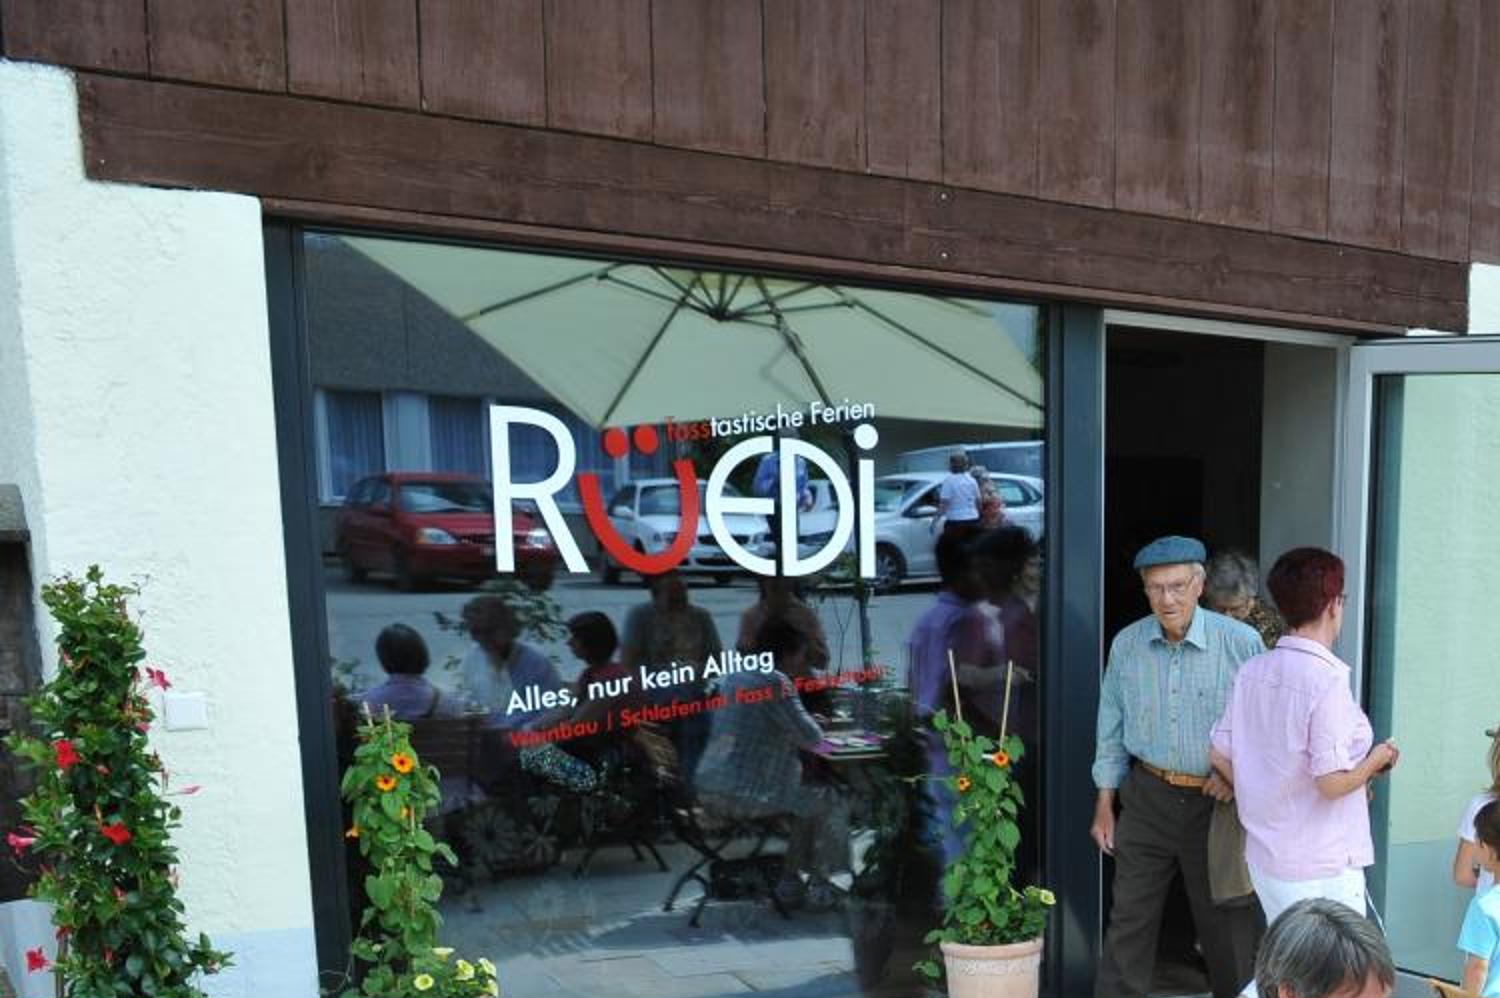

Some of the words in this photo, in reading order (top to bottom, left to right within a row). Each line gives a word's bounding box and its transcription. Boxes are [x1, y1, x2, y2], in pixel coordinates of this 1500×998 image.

[811, 399, 875, 424] Ferien
[506, 685, 578, 716] Alles,
[588, 676, 633, 700] nur
[640, 662, 695, 690] kein
[702, 650, 774, 679] Alltag
[511, 719, 598, 747] Weinbau
[620, 700, 702, 728] Schlafen
